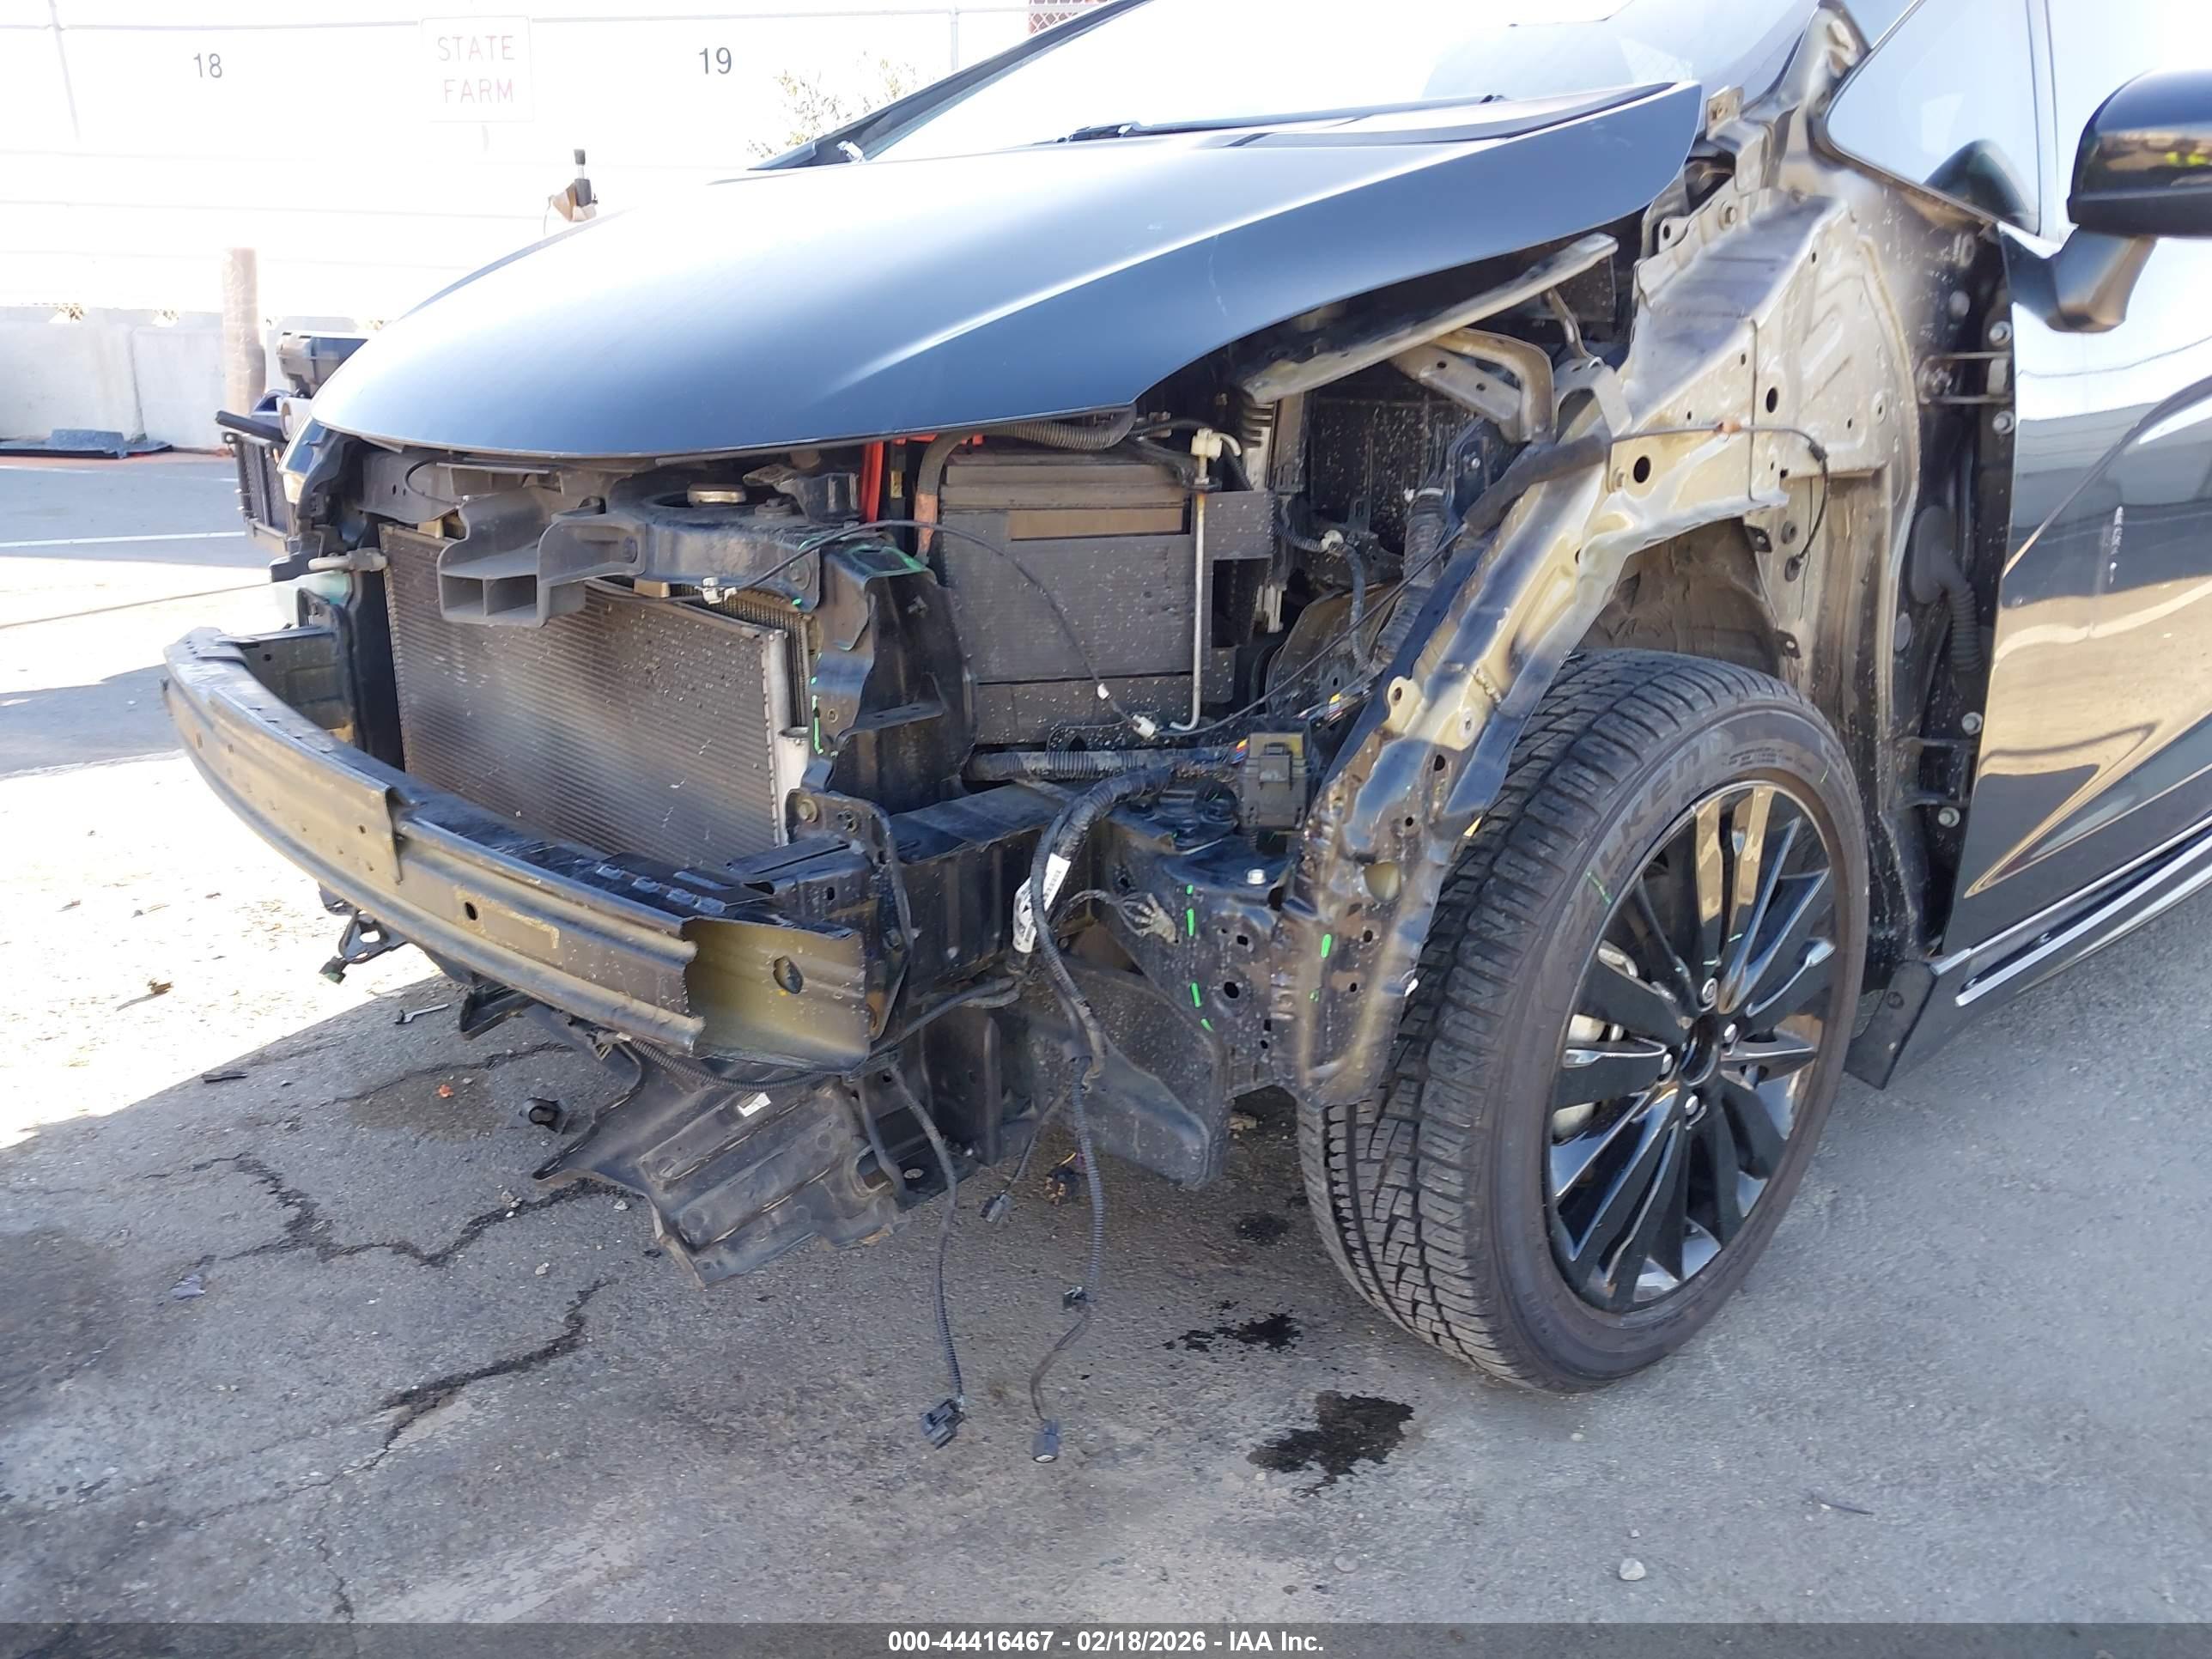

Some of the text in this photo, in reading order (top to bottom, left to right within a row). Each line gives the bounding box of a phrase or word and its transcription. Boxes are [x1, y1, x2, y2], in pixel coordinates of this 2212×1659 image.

[437, 34, 515, 62] STATE
[698, 46, 732, 75] 19
[193, 52, 223, 79] 18
[443, 77, 514, 104] FARM
